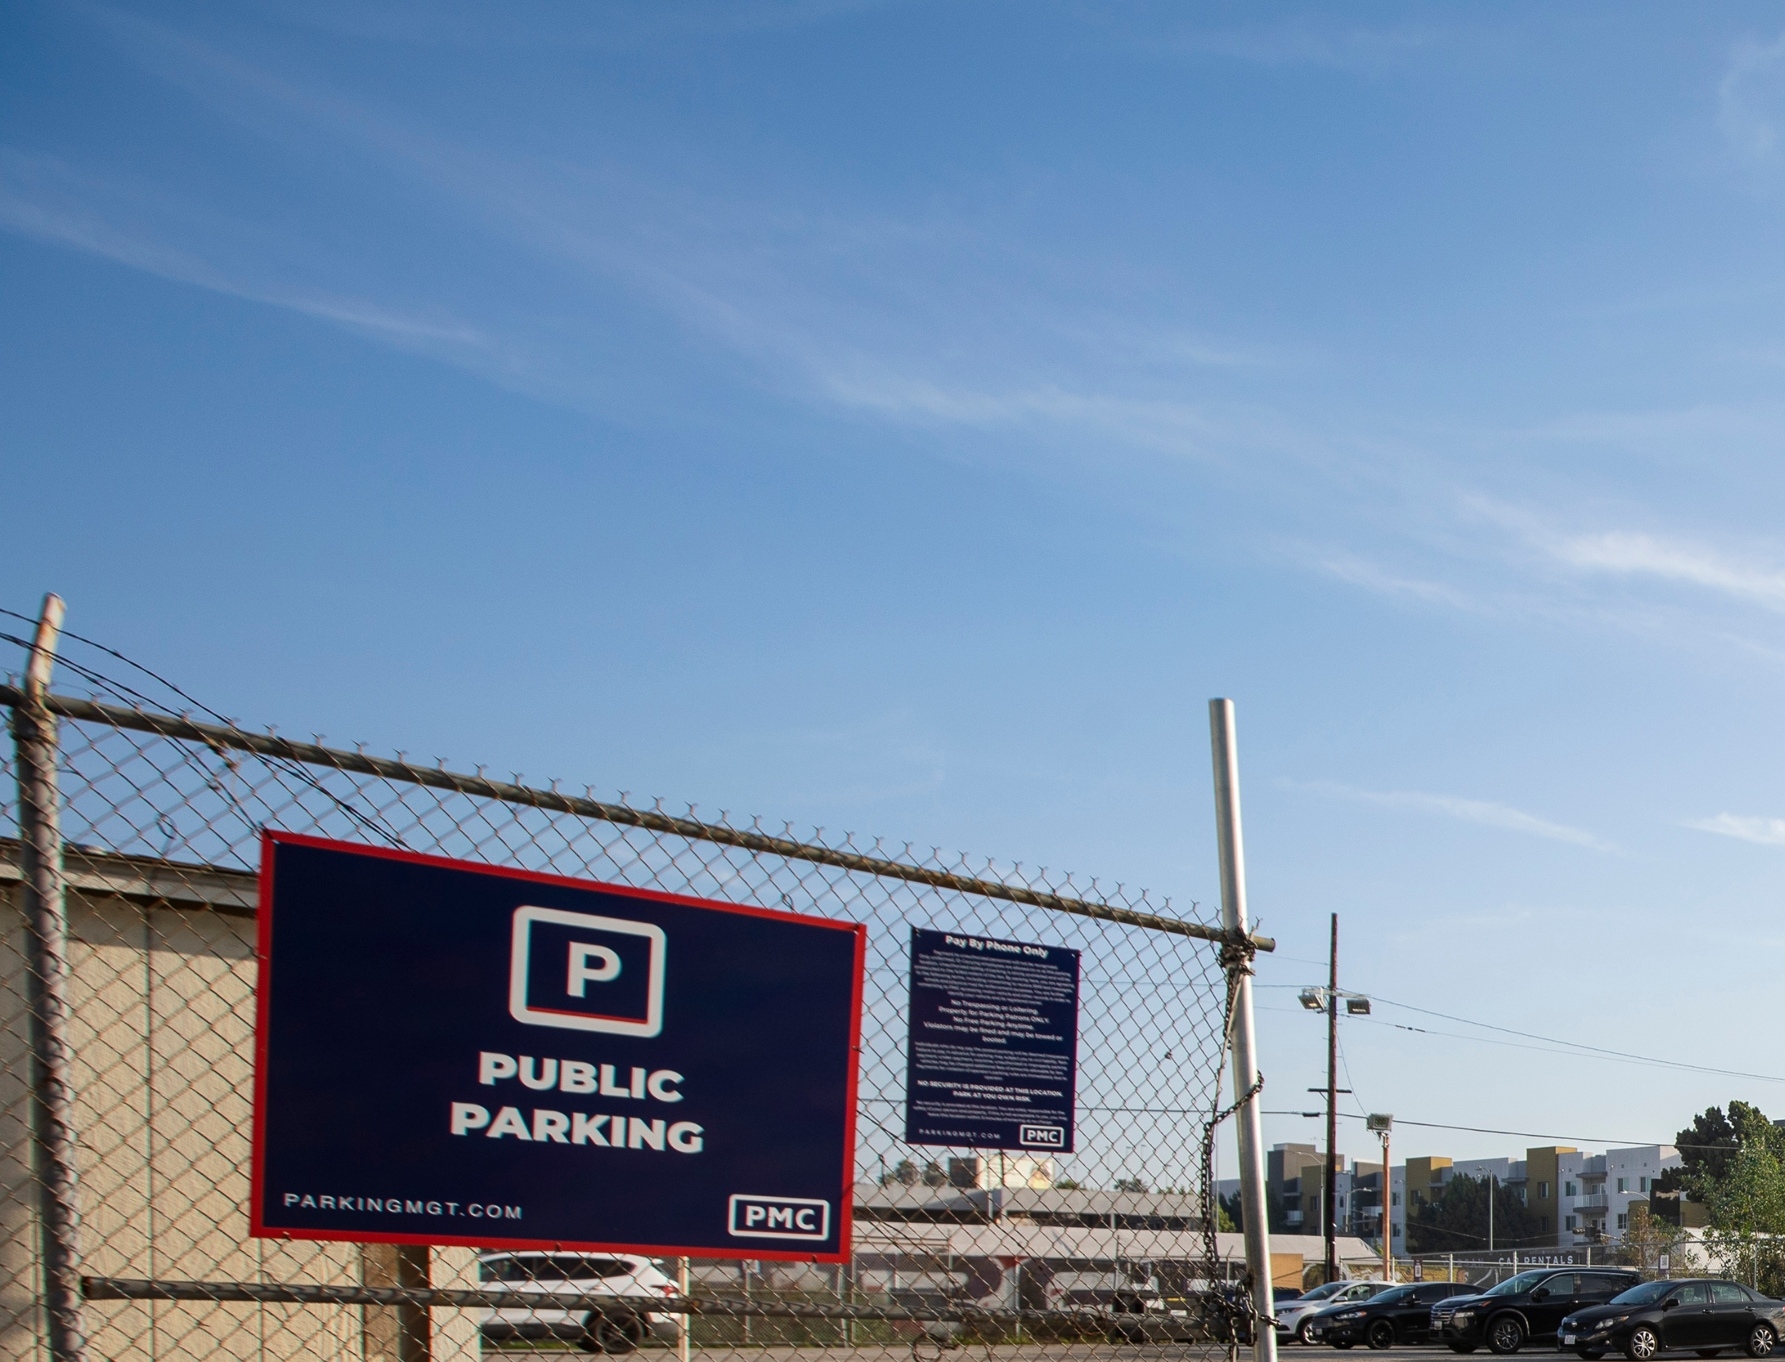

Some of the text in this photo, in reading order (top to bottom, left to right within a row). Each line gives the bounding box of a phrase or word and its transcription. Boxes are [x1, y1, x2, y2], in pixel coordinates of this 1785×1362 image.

[945, 935, 1049, 959] Pay By Phone Only
[566, 941, 622, 998] P
[962, 1000, 1000, 1011] Trespassing
[979, 1010, 1005, 1020] Parking
[1005, 1013, 1030, 1021] Patrons
[923, 1021, 954, 1030] Violators
[980, 1019, 1005, 1028] Parking
[478, 1050, 684, 1102] PUBLIC
[970, 1084, 1004, 1092] PROVIDED
[450, 1101, 704, 1154] PARKING
[1026, 1129, 1059, 1142] PMC
[283, 1191, 523, 1220] PARKINGMGT.COM
[745, 1204, 817, 1231] PMC
[1524, 1255, 1574, 1265] RENTALS
